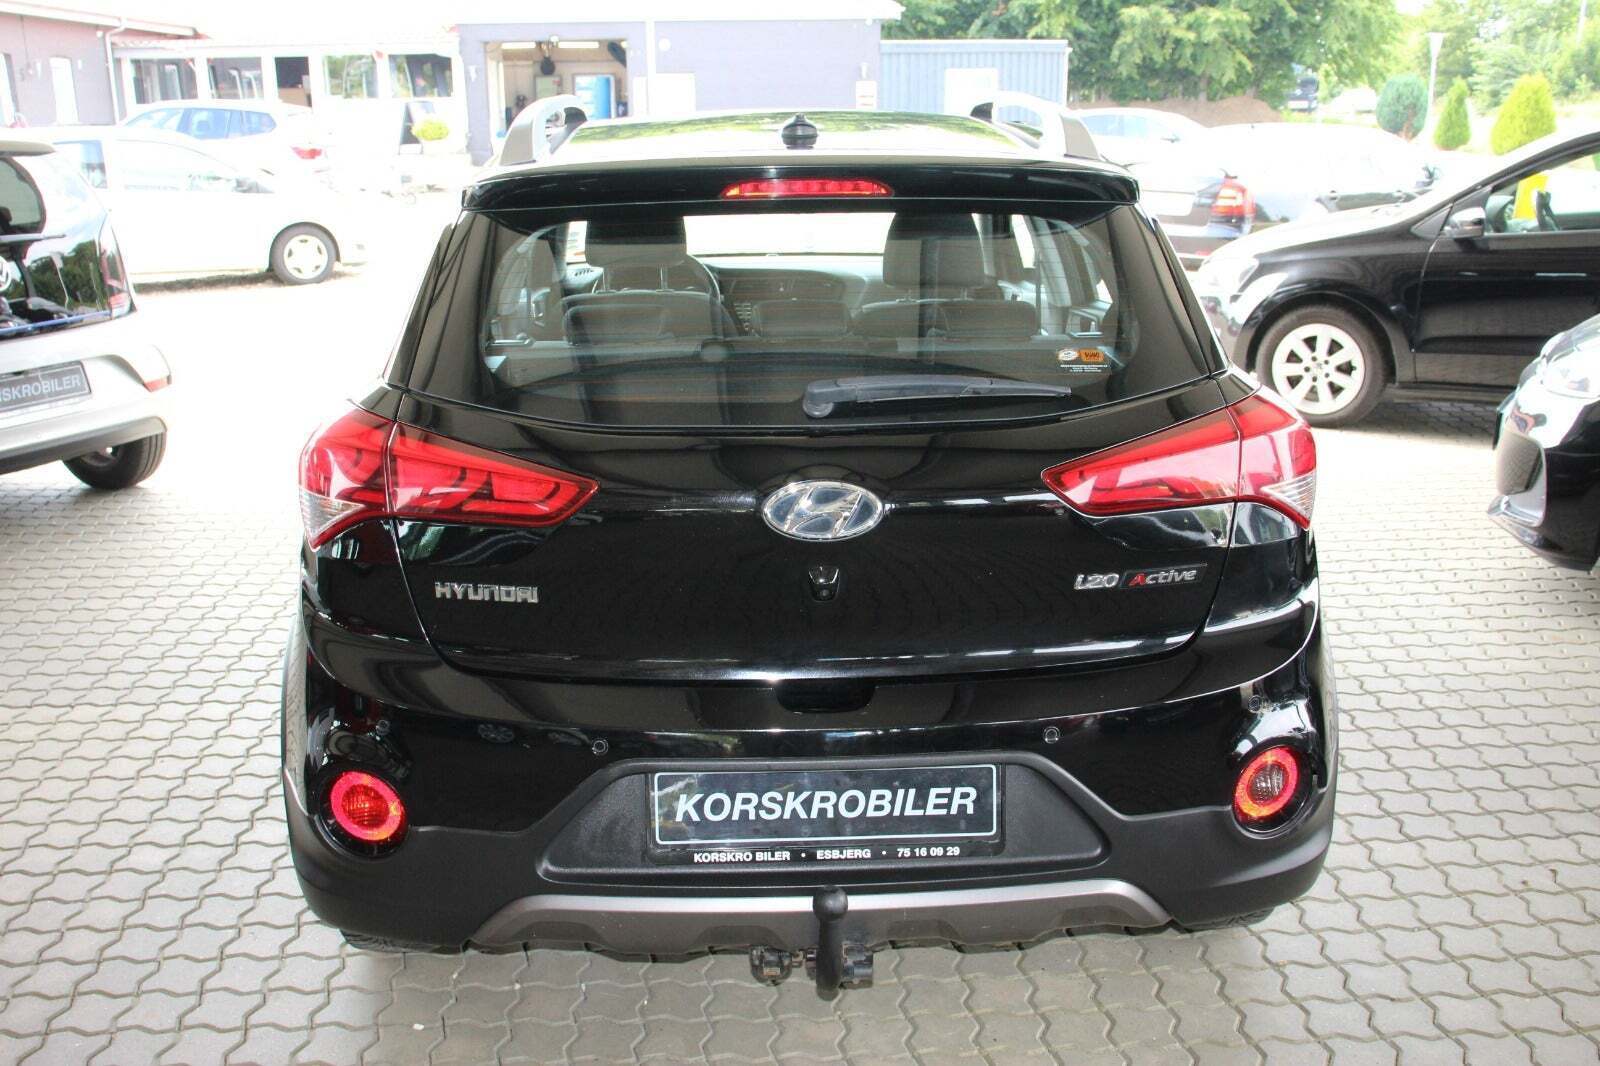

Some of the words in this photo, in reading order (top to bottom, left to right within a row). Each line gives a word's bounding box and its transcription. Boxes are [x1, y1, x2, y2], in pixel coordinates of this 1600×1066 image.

[0, 375, 81, 402] SKROBILER
[1128, 569, 1197, 586] Active
[435, 582, 538, 603] HYUNDAI
[675, 786, 977, 822] KORSKROBILER
[693, 852, 752, 863] KORSKRO
[755, 851, 791, 861] BILER
[816, 849, 871, 859] ESBJERG
[897, 848, 911, 857] 75
[914, 847, 927, 857] 16
[930, 847, 943, 856] 09
[946, 846, 960, 856] 29
